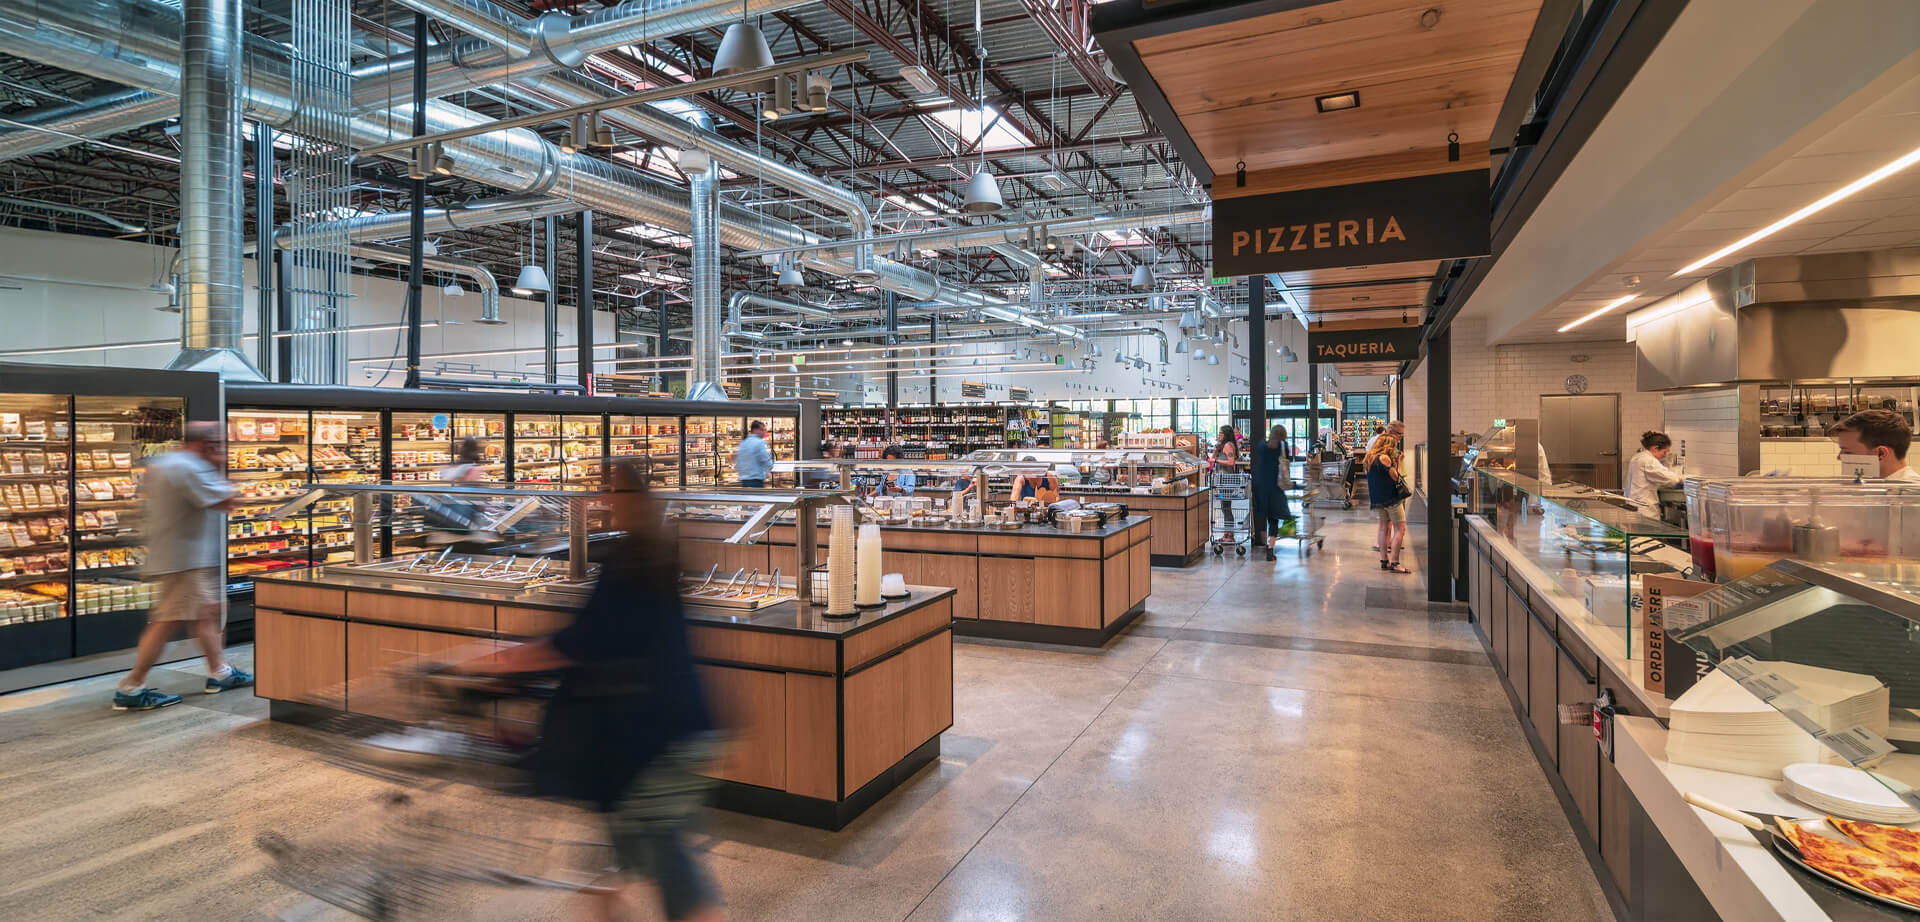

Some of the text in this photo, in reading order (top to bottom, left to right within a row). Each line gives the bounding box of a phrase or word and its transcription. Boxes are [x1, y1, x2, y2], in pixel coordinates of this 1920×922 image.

[1232, 215, 1407, 256] PIZZERIA
[1316, 341, 1396, 358] TAQUERIA
[1649, 631, 1662, 683] ORDER
